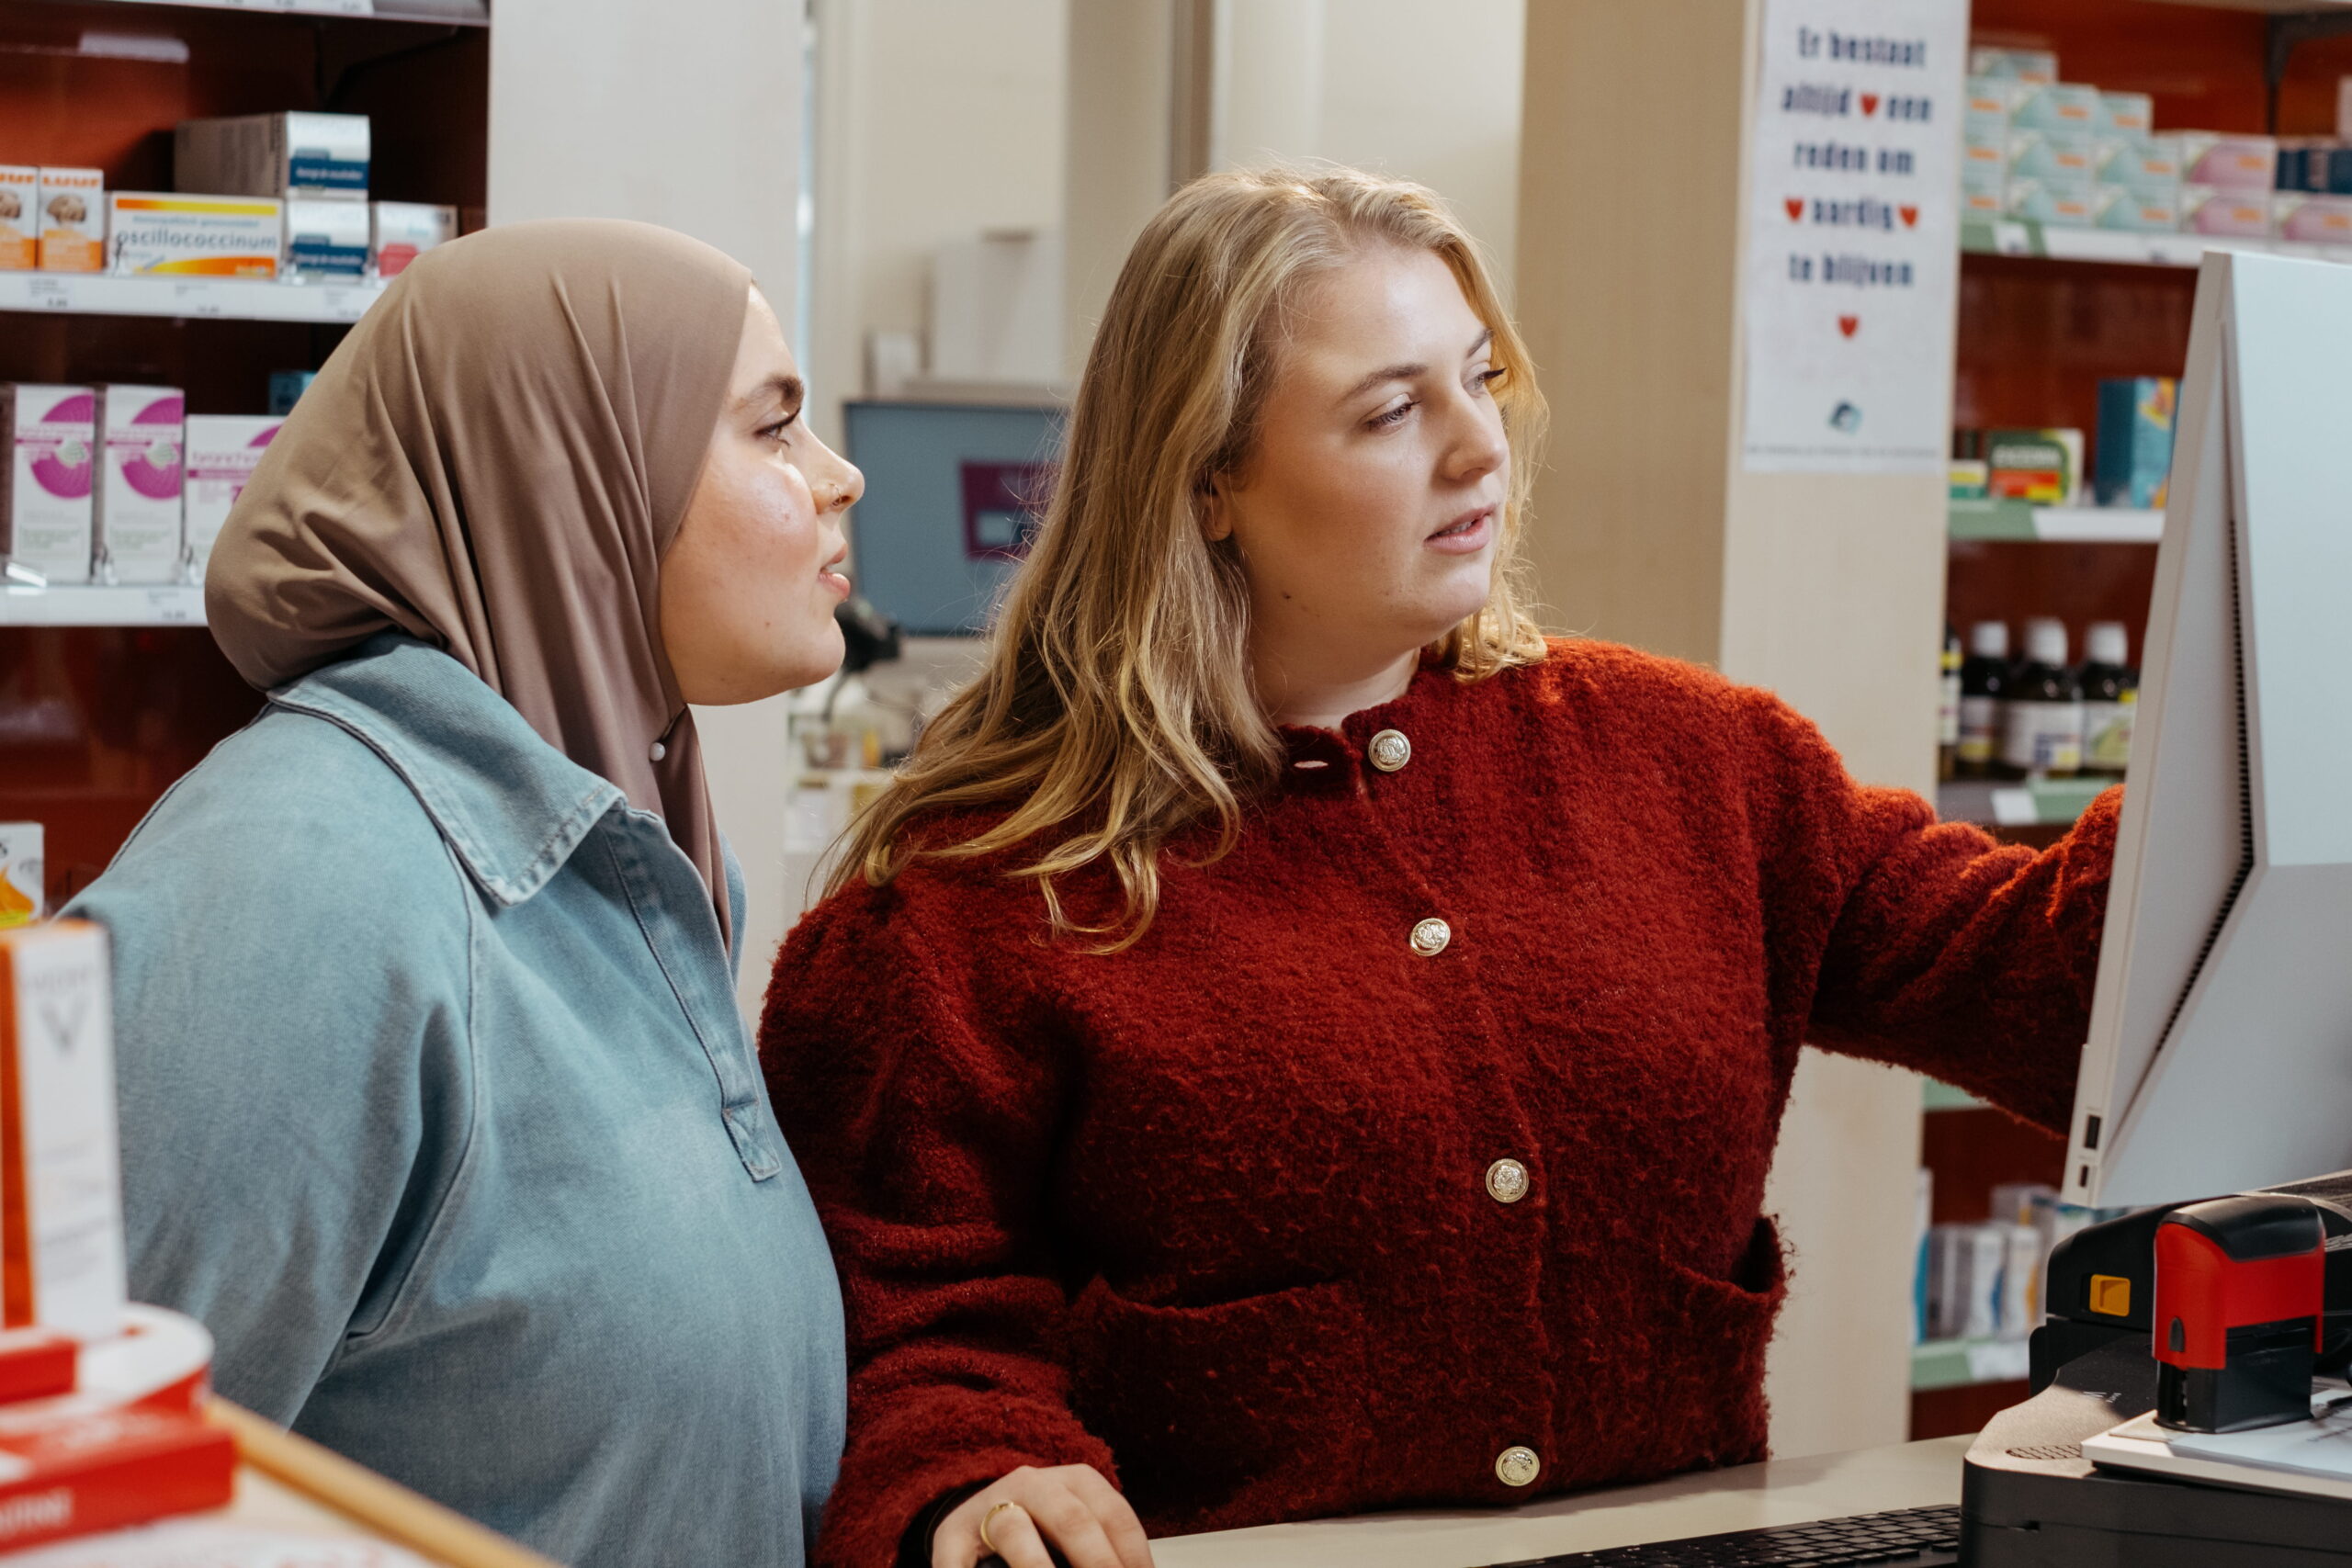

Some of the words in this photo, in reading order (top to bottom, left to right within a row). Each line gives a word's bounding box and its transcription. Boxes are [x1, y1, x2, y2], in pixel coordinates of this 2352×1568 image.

[1798, 25, 1820, 58] Er
[1829, 31, 1926, 67] bestaat
[1783, 82, 1850, 117] altijd
[1888, 96, 1932, 122] een
[1794, 140, 1867, 171] reden
[1878, 150, 1914, 175] om
[1814, 195, 1893, 232] aardig
[116, 228, 277, 250] oscillococcinum
[1790, 253, 1813, 280] te
[1824, 254, 1913, 289] blijven
